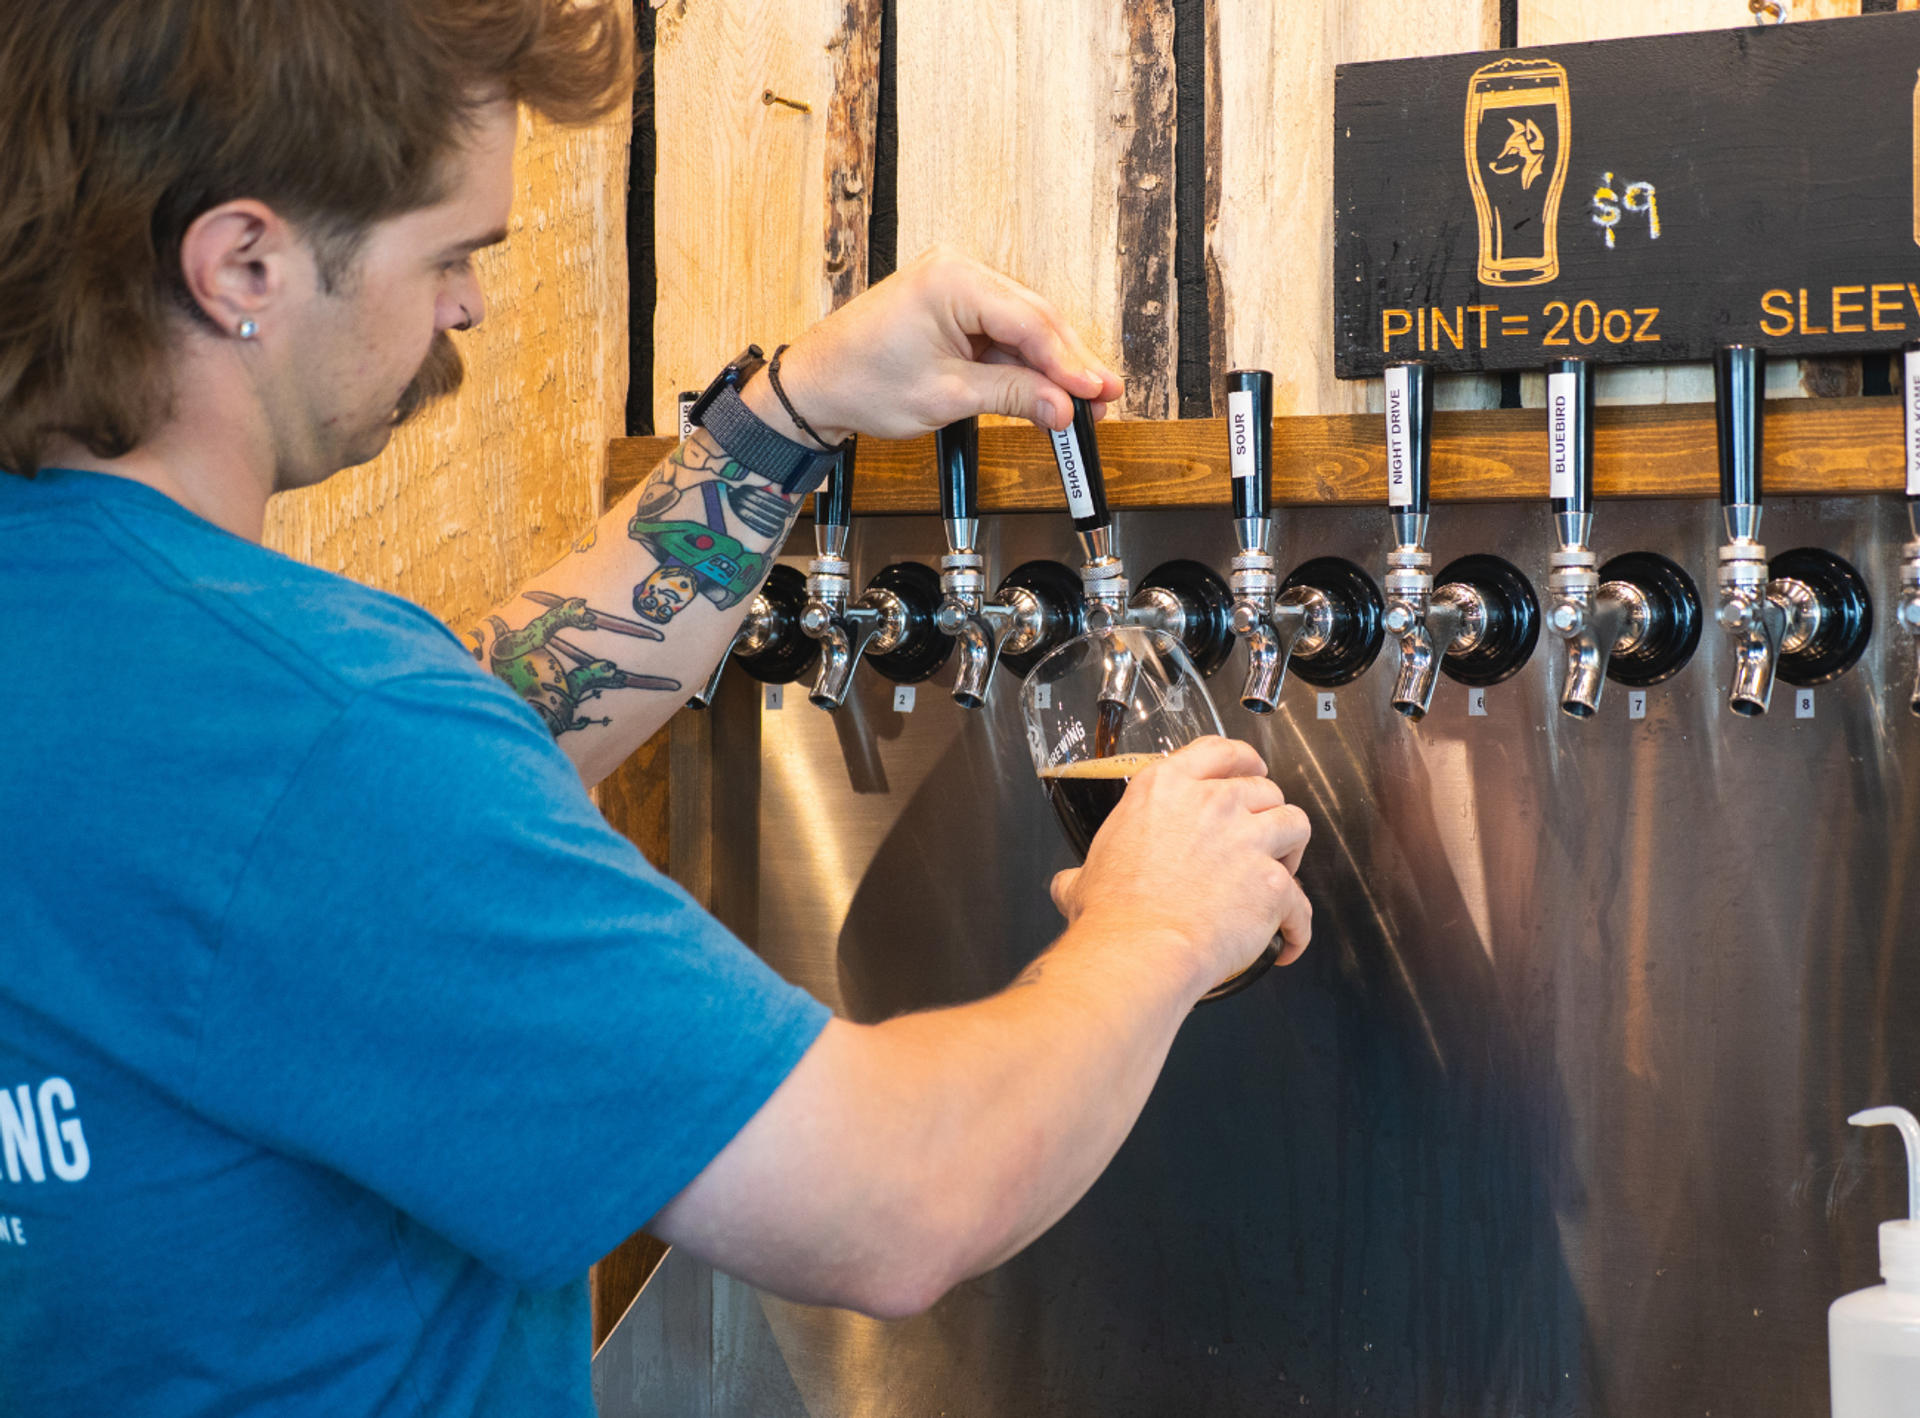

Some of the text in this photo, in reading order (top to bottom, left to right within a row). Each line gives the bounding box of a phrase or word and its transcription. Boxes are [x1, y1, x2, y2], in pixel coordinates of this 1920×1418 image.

[1592, 171, 1661, 249] $9
[1382, 299, 1661, 353] PINT= 20oz
[1234, 413, 1246, 455] SOUR
[1390, 388, 1403, 485] NIGHT DRIVE
[1555, 395, 1566, 474] BLUEBIRD
[772, 692, 777, 703] 1
[899, 694, 905, 705] 2
[1324, 701, 1331, 712] 5
[1635, 700, 1642, 711] 7
[1802, 698, 1810, 710] 8
